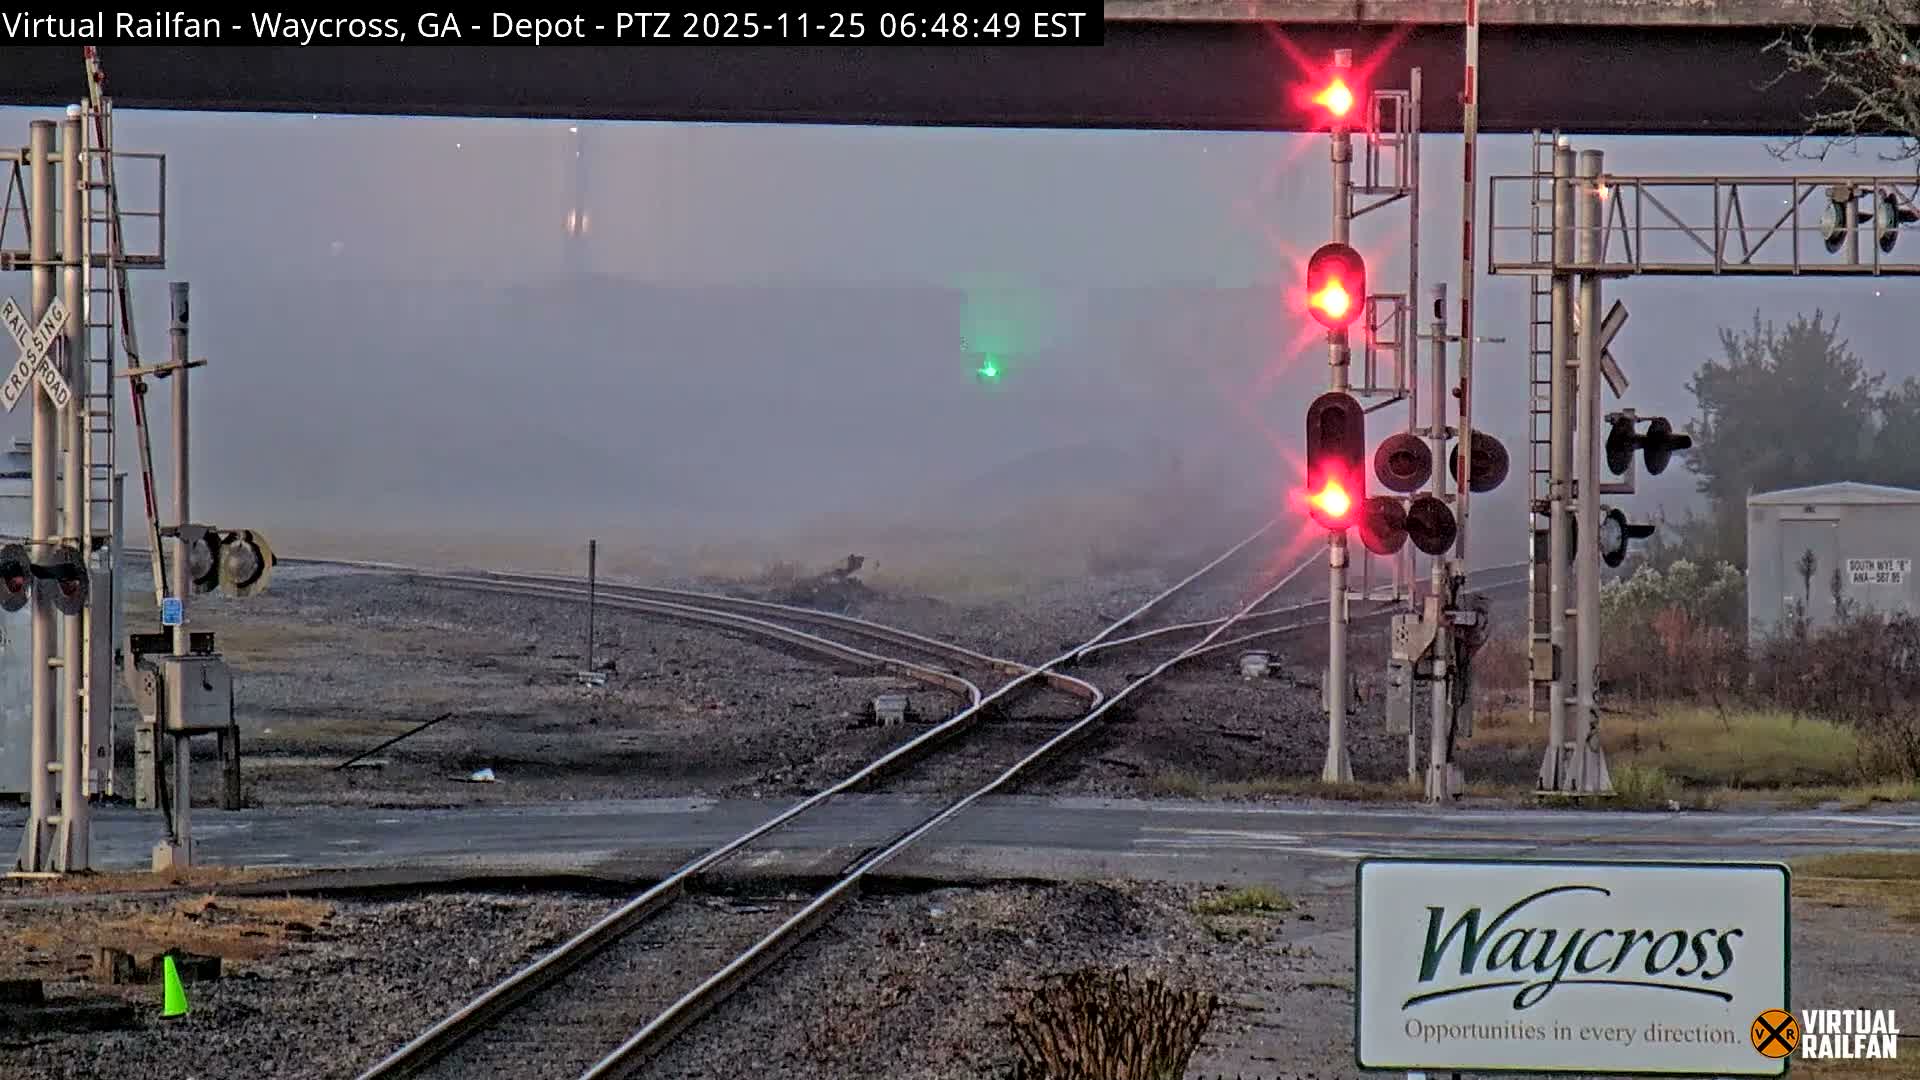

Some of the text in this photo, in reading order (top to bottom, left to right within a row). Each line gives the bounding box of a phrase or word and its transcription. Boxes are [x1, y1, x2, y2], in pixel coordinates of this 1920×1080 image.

[2, 302, 68, 405] RAIL ROAD
[4, 304, 63, 402] CROSSING
[1849, 560, 1874, 571] SOUTH
[1418, 885, 1744, 1011] Waycross
[1404, 1018, 1742, 1047] Opportunities in every direction.
